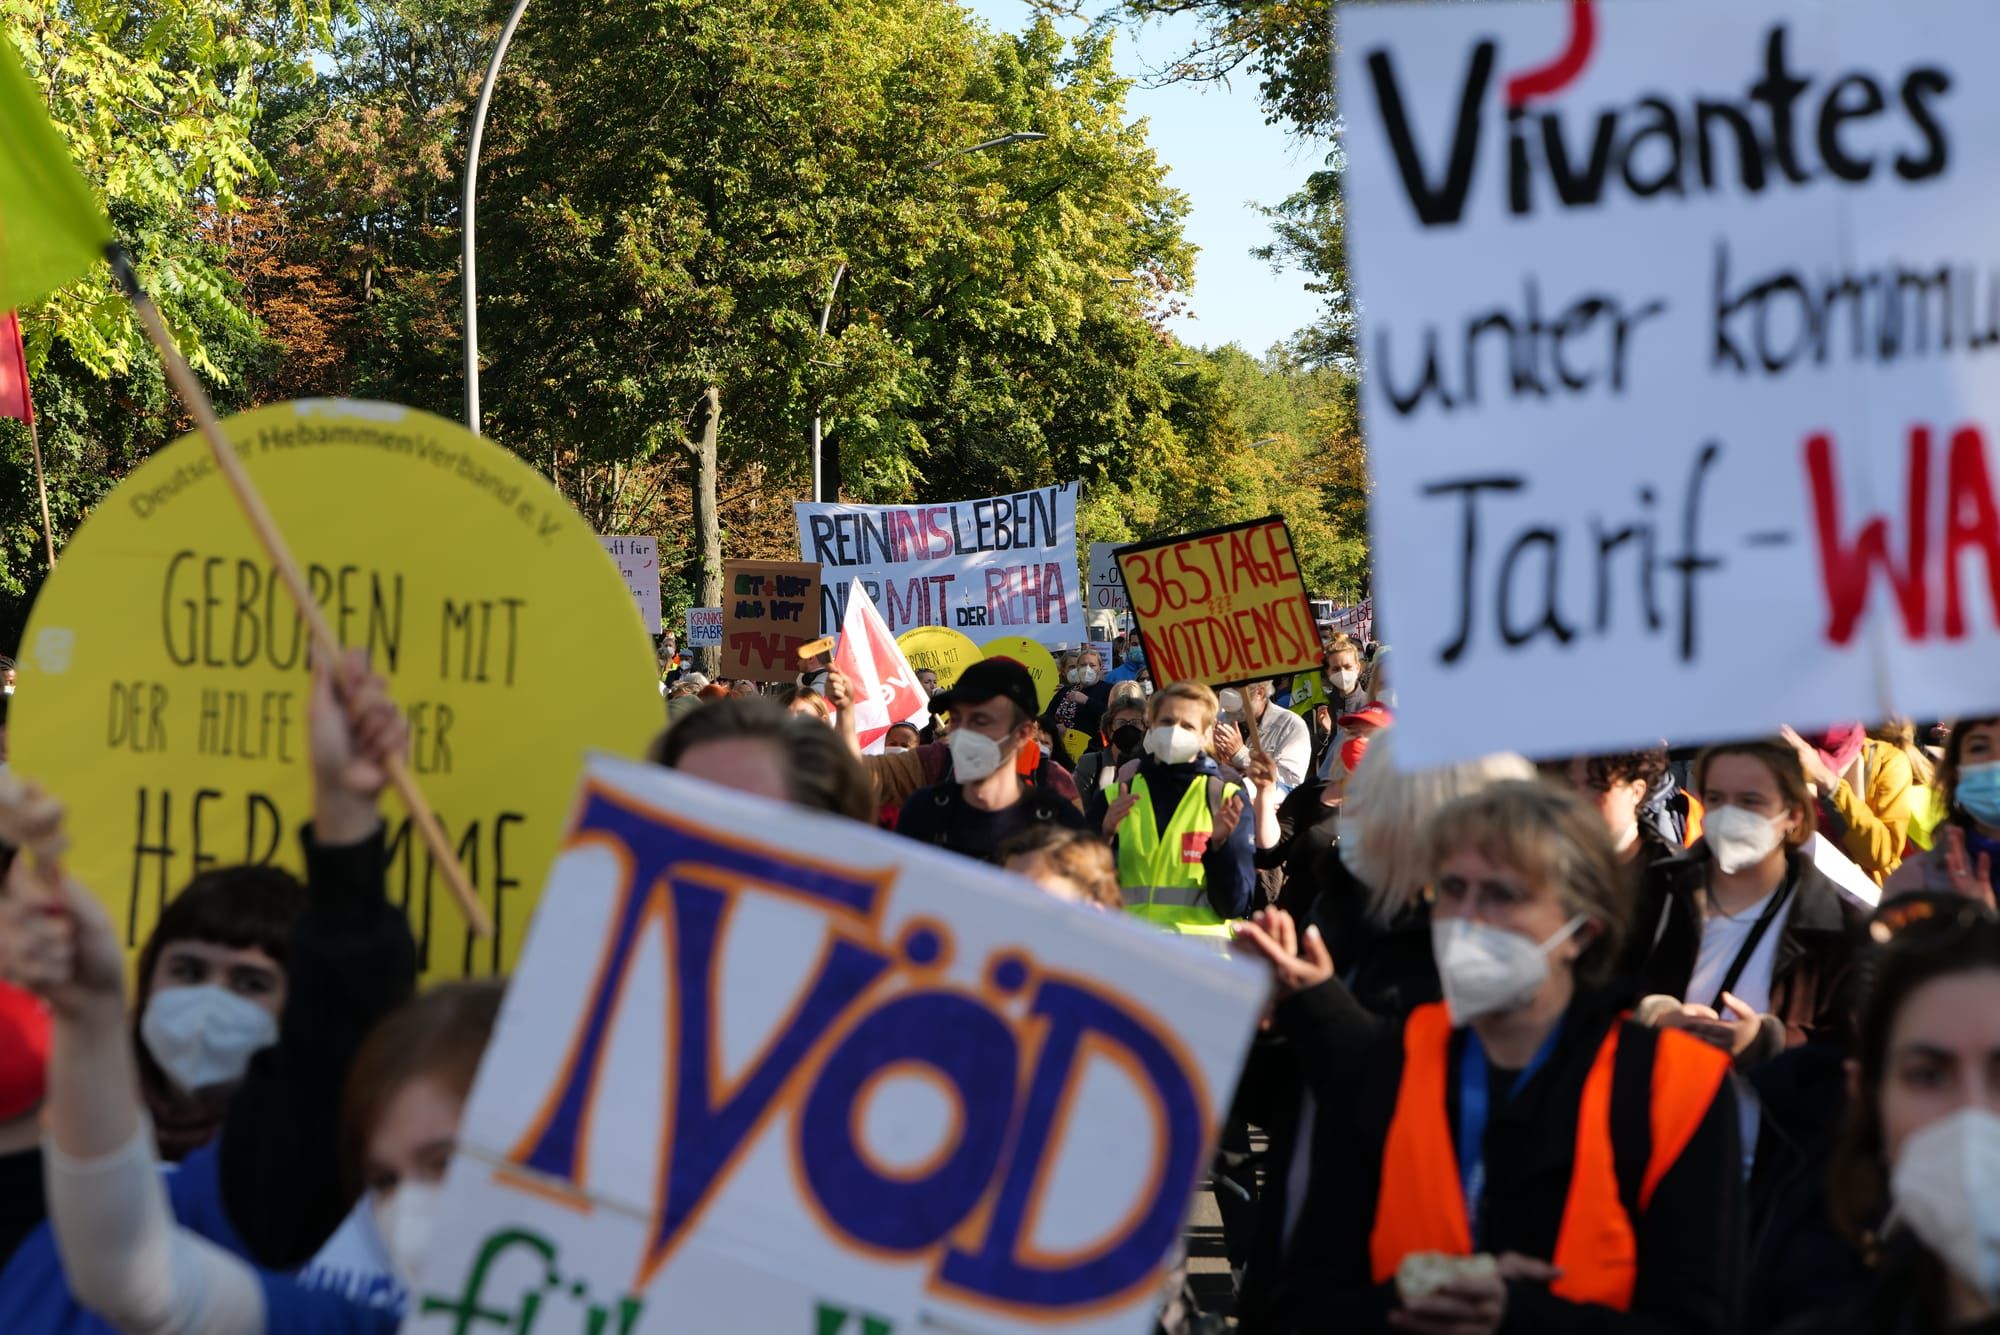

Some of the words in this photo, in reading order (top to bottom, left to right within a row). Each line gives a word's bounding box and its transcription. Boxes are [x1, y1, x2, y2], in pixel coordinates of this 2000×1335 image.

[1365, 22, 1953, 229] Vivantes
[1373, 272, 1670, 418] unter
[631, 541, 650, 555] für
[1199, 521, 1299, 595] TAGE
[886, 575, 955, 632] MIT
[956, 606, 987, 627] DER
[985, 562, 1069, 626] REHA
[439, 596, 527, 687] MIT
[943, 647, 961, 664] MIT
[1142, 591, 1326, 690] NOTDIENST!
[107, 680, 169, 753] DER
[198, 687, 297, 765] HILFE
